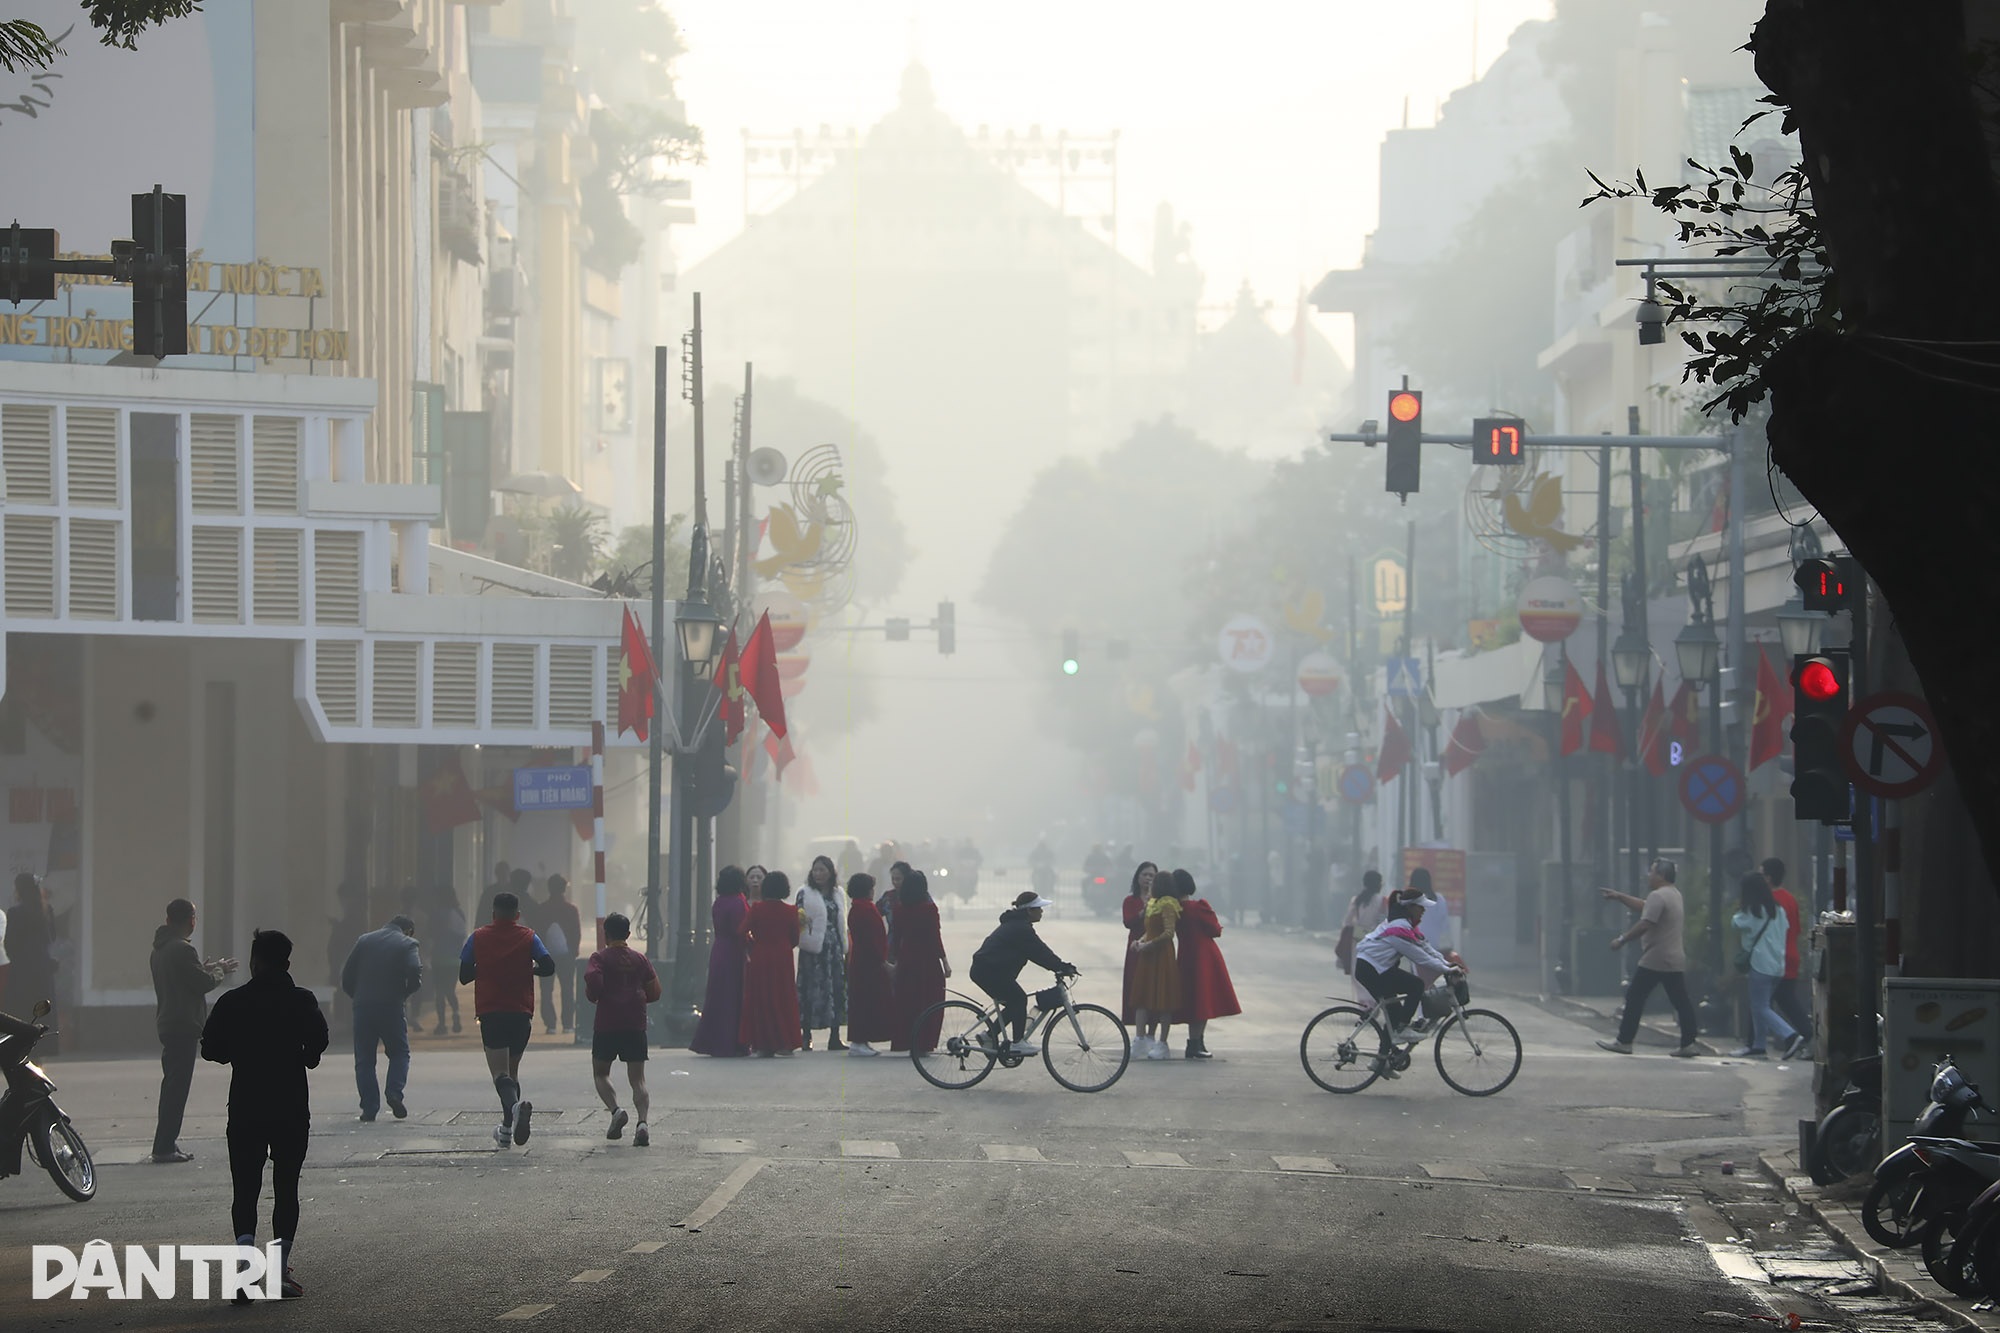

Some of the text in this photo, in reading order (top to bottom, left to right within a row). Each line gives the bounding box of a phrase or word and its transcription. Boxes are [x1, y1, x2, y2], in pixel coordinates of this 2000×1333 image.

[300, 267, 326, 298] TA
[210, 326, 240, 356] TO
[244, 327, 289, 365] ĐẸP
[1491, 426, 1519, 456] 17
